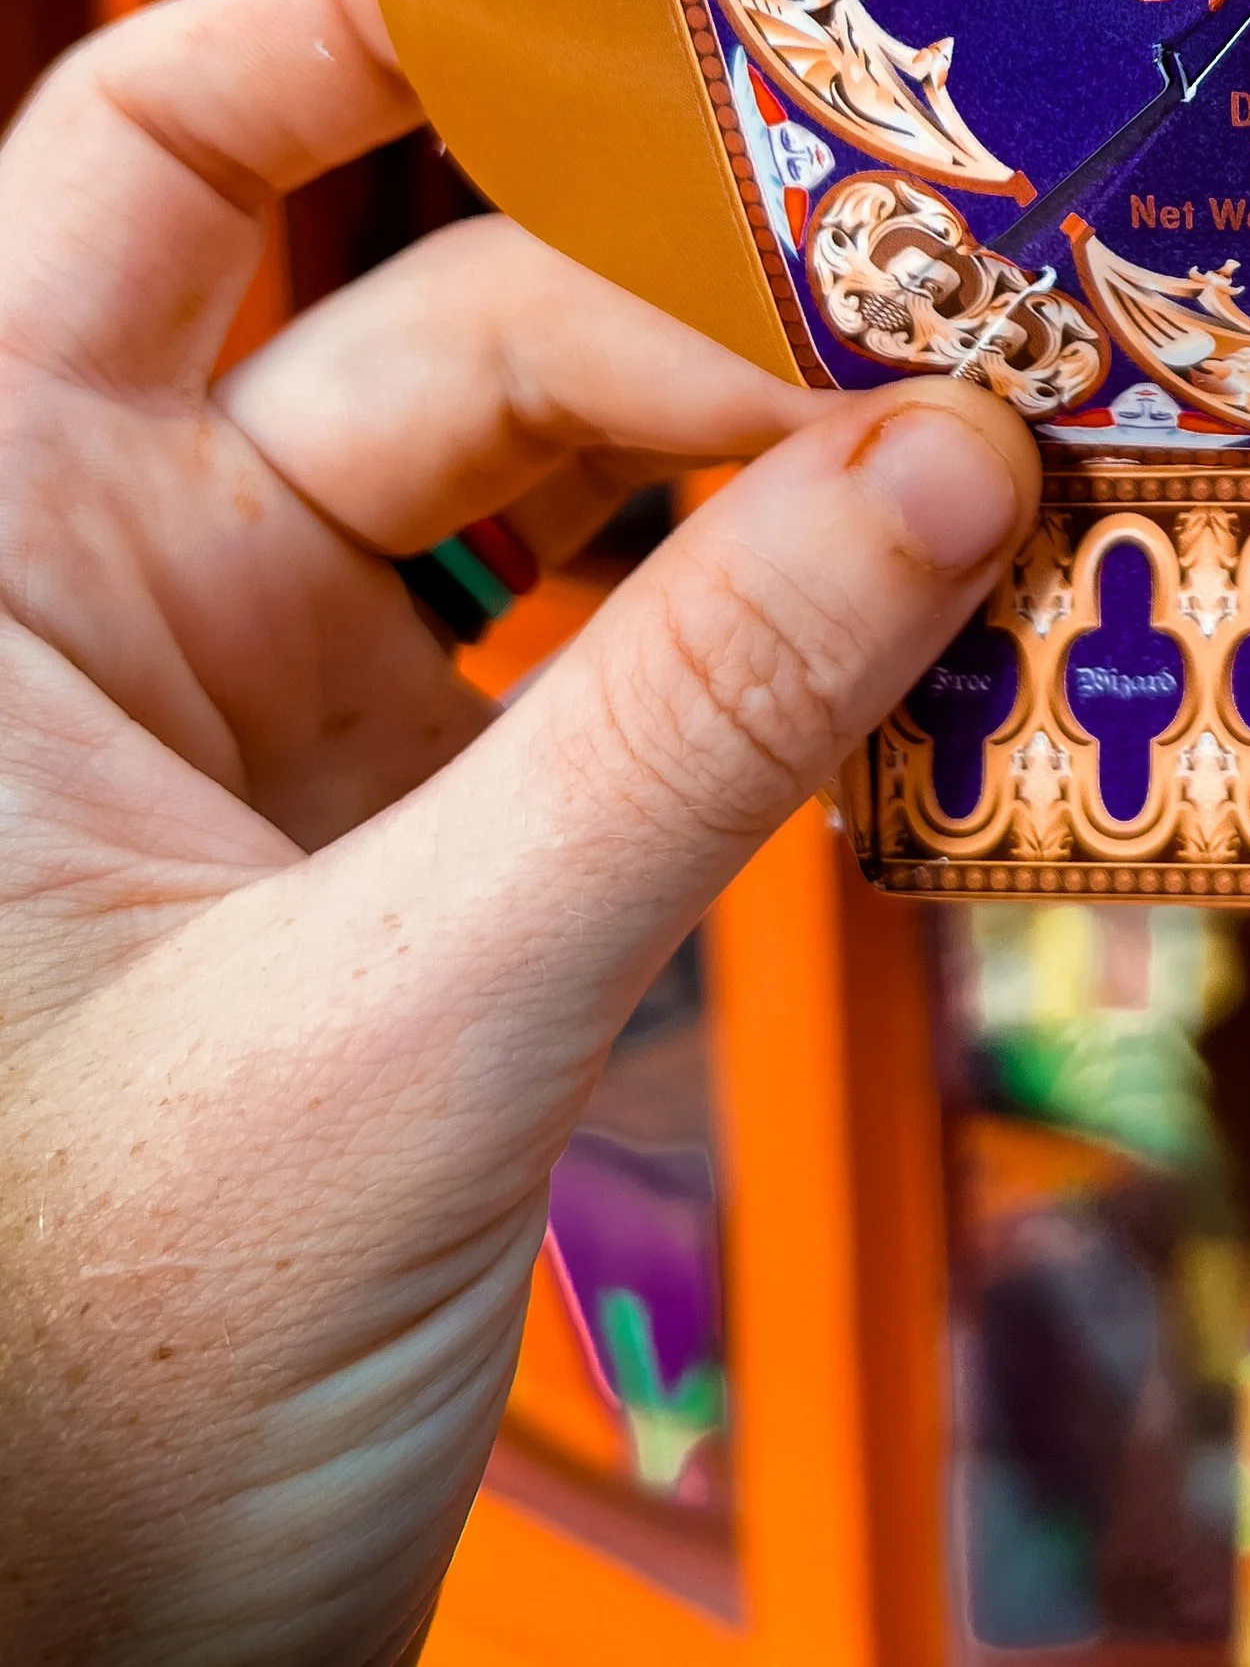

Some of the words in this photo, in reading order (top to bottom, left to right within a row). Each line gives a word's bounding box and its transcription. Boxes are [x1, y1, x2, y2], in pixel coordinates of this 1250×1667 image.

[1130, 194, 1194, 230] Net
[929, 666, 992, 693] Free
[1075, 666, 1178, 700] Wizard
